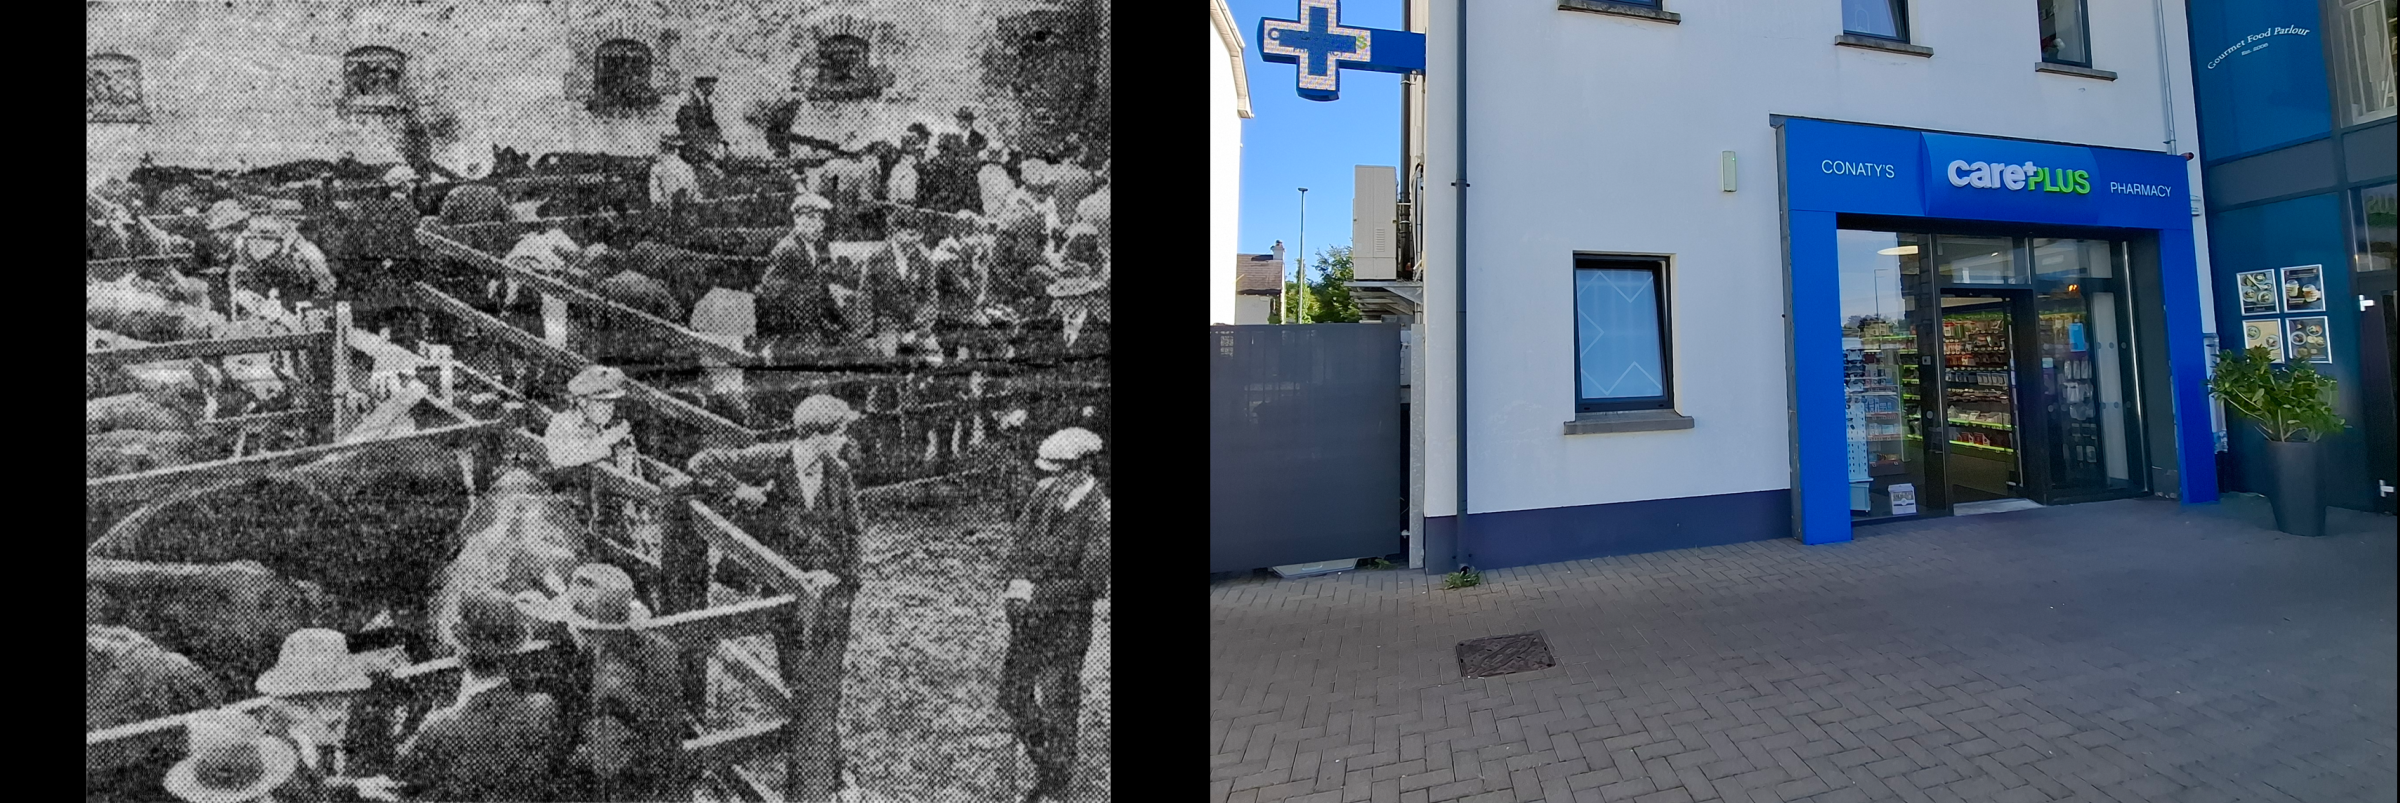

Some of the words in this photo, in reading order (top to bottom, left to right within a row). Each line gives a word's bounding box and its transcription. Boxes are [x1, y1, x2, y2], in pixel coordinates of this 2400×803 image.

[2207, 40, 2246, 70] Gourmet
[2247, 28, 2271, 44] Food
[2274, 24, 2310, 36] Parlour
[1821, 159, 1895, 179] CONATY'S
[2110, 181, 2172, 198] PHARMACY
